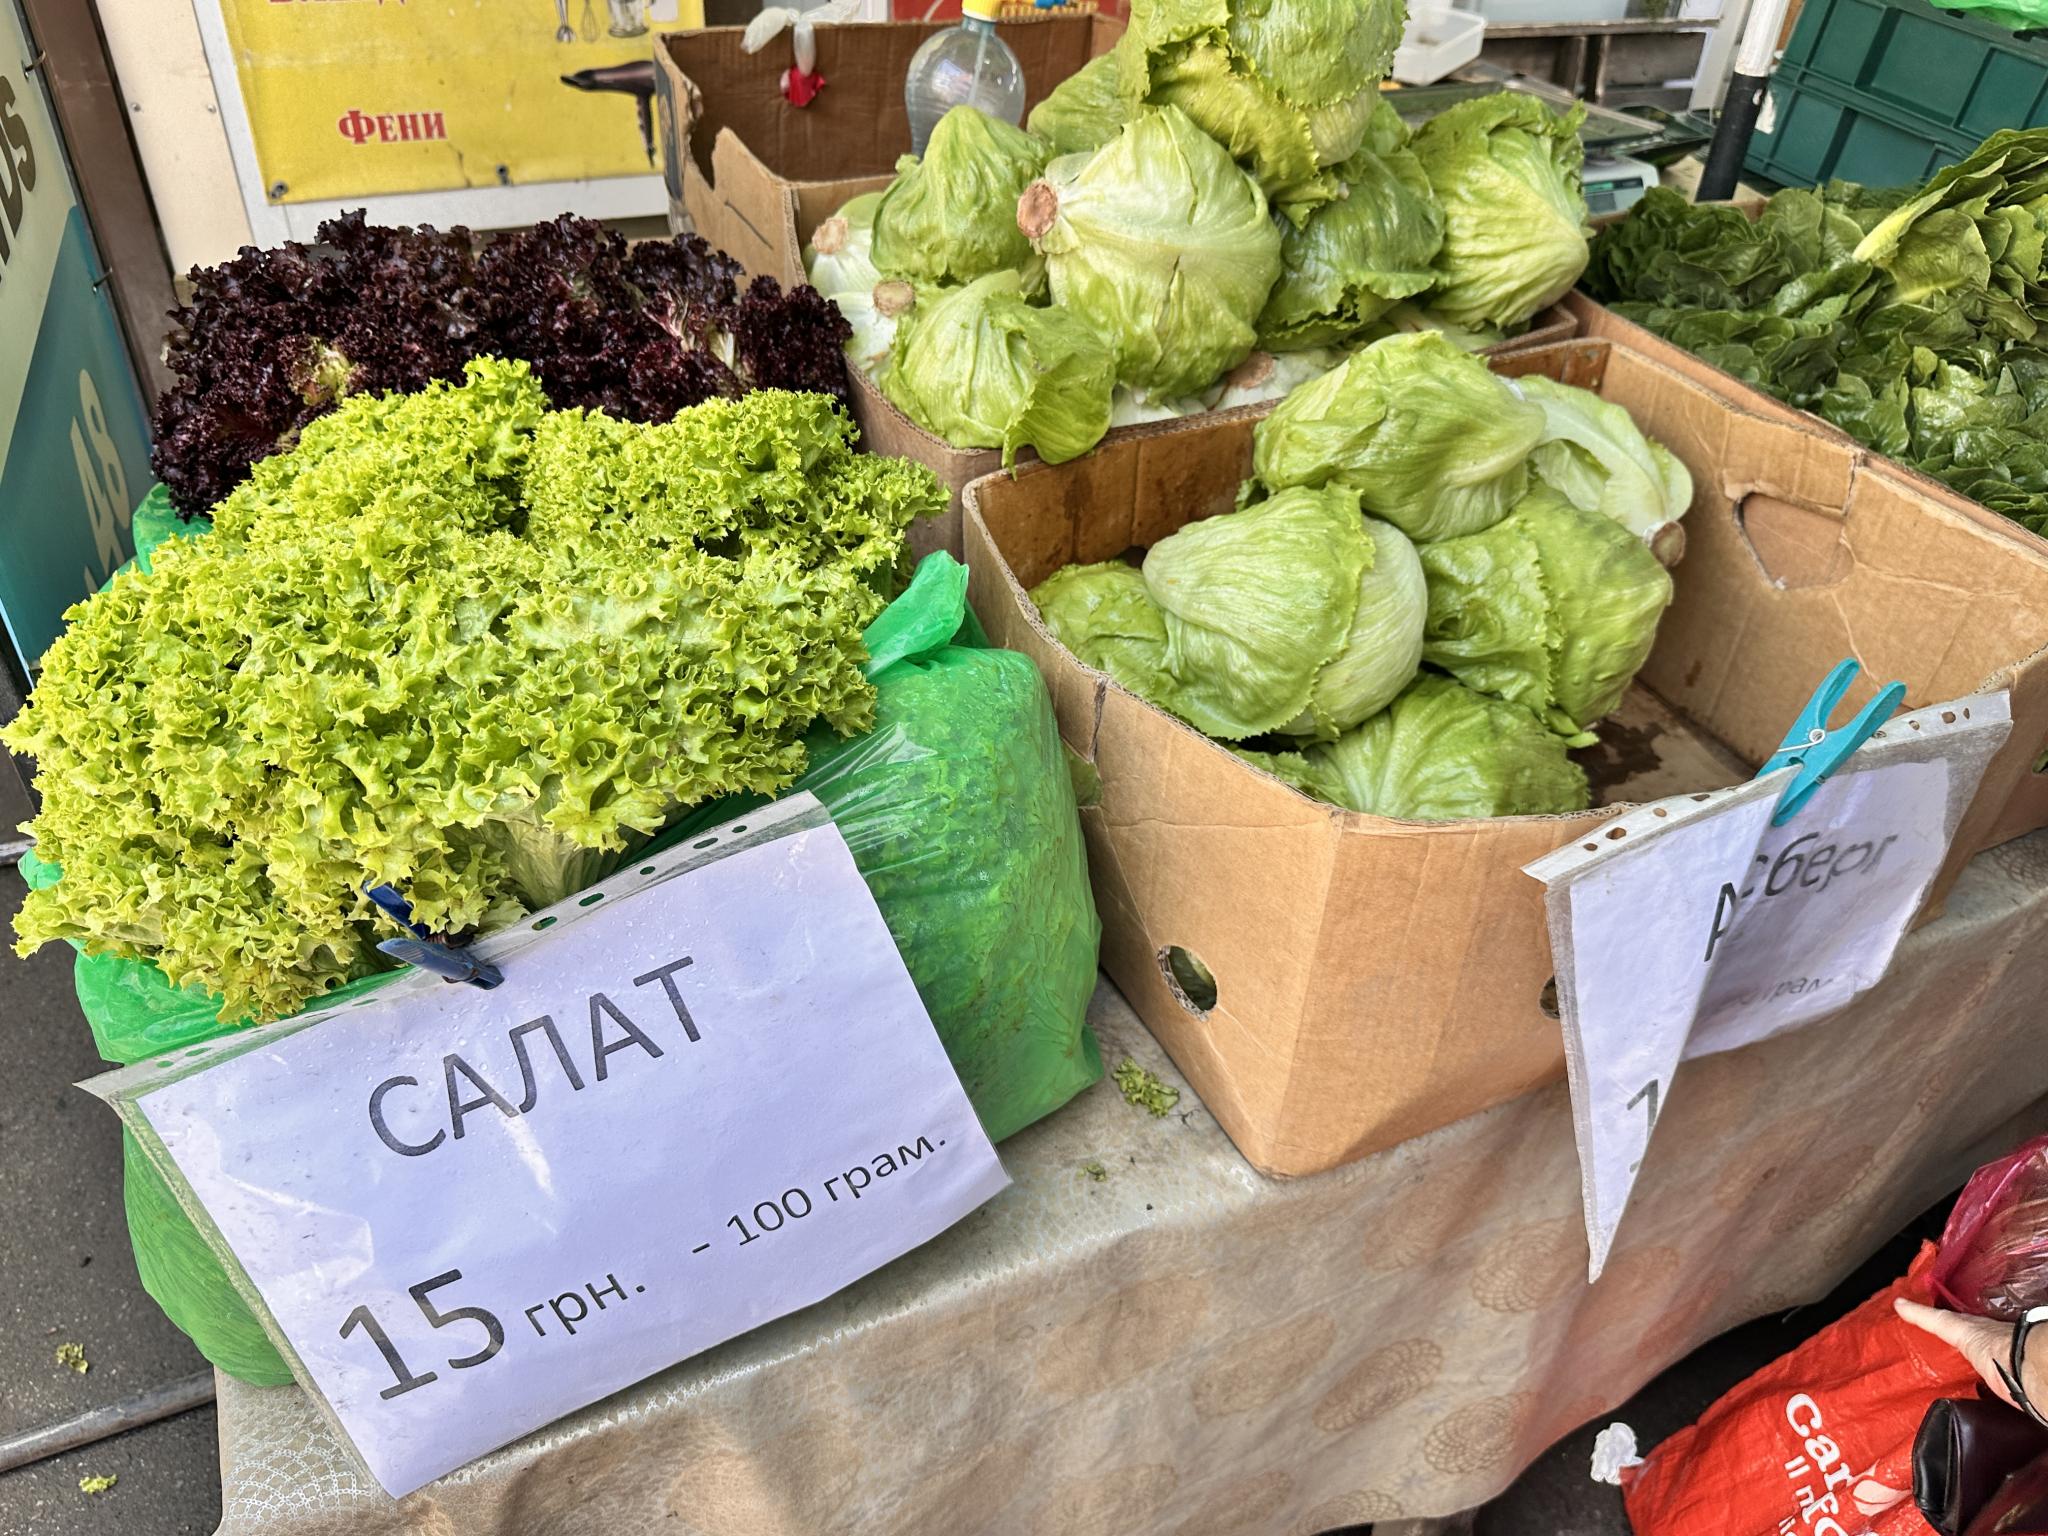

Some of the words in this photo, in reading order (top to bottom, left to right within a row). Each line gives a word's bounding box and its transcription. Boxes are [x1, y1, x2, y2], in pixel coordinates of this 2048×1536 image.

[338, 109, 447, 145] ФЕНИ
[70, 369, 131, 592] 48
[368, 955, 702, 1156] САЛАТ
[339, 1268, 505, 1400] 15
[524, 1272, 646, 1336] грн.
[726, 1187, 812, 1246] 100
[823, 1135, 947, 1201] грам.
